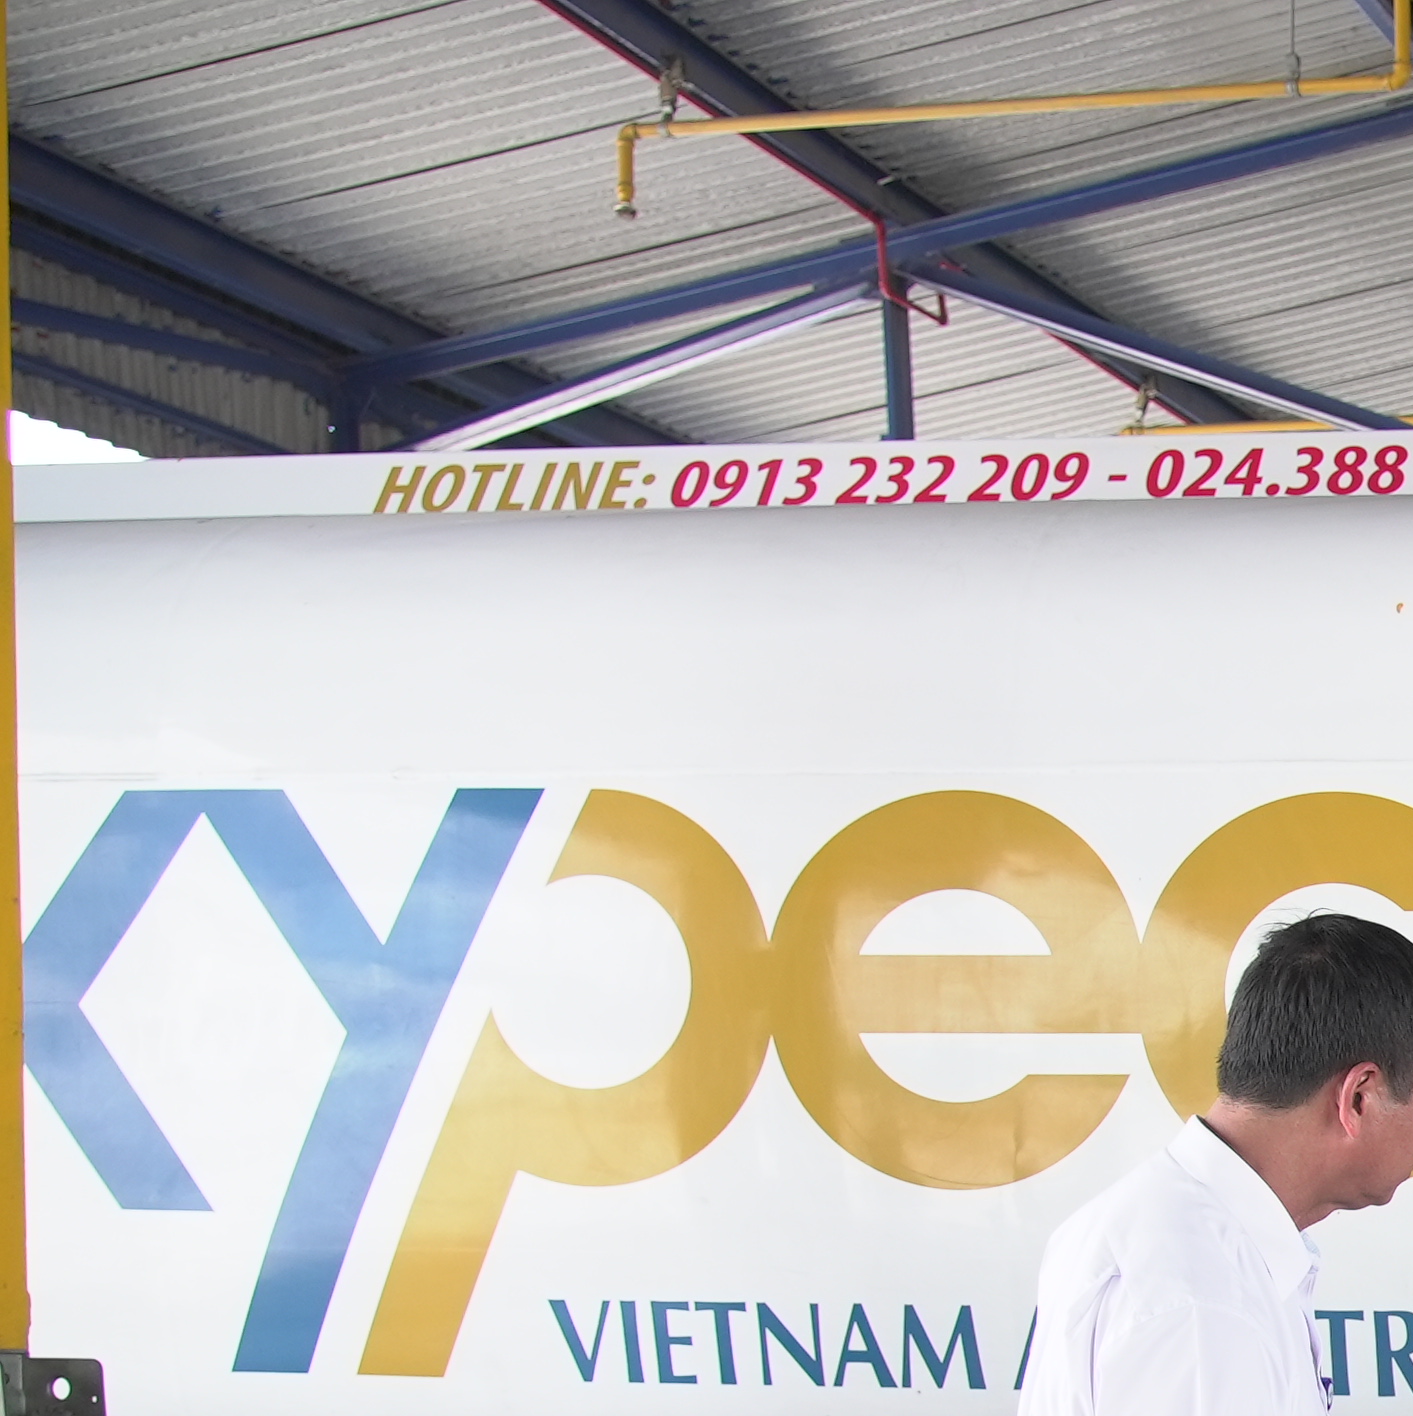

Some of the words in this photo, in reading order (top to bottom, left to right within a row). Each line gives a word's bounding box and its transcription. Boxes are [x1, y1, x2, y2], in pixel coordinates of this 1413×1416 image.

[374, 462, 654, 513] HOTLINE:
[671, 456, 819, 509] 0913
[834, 456, 950, 506] 232
[966, 452, 1090, 503] 209
[1146, 446, 1407, 500] 024.388
[549, 1298, 988, 1391] VIETNAM
